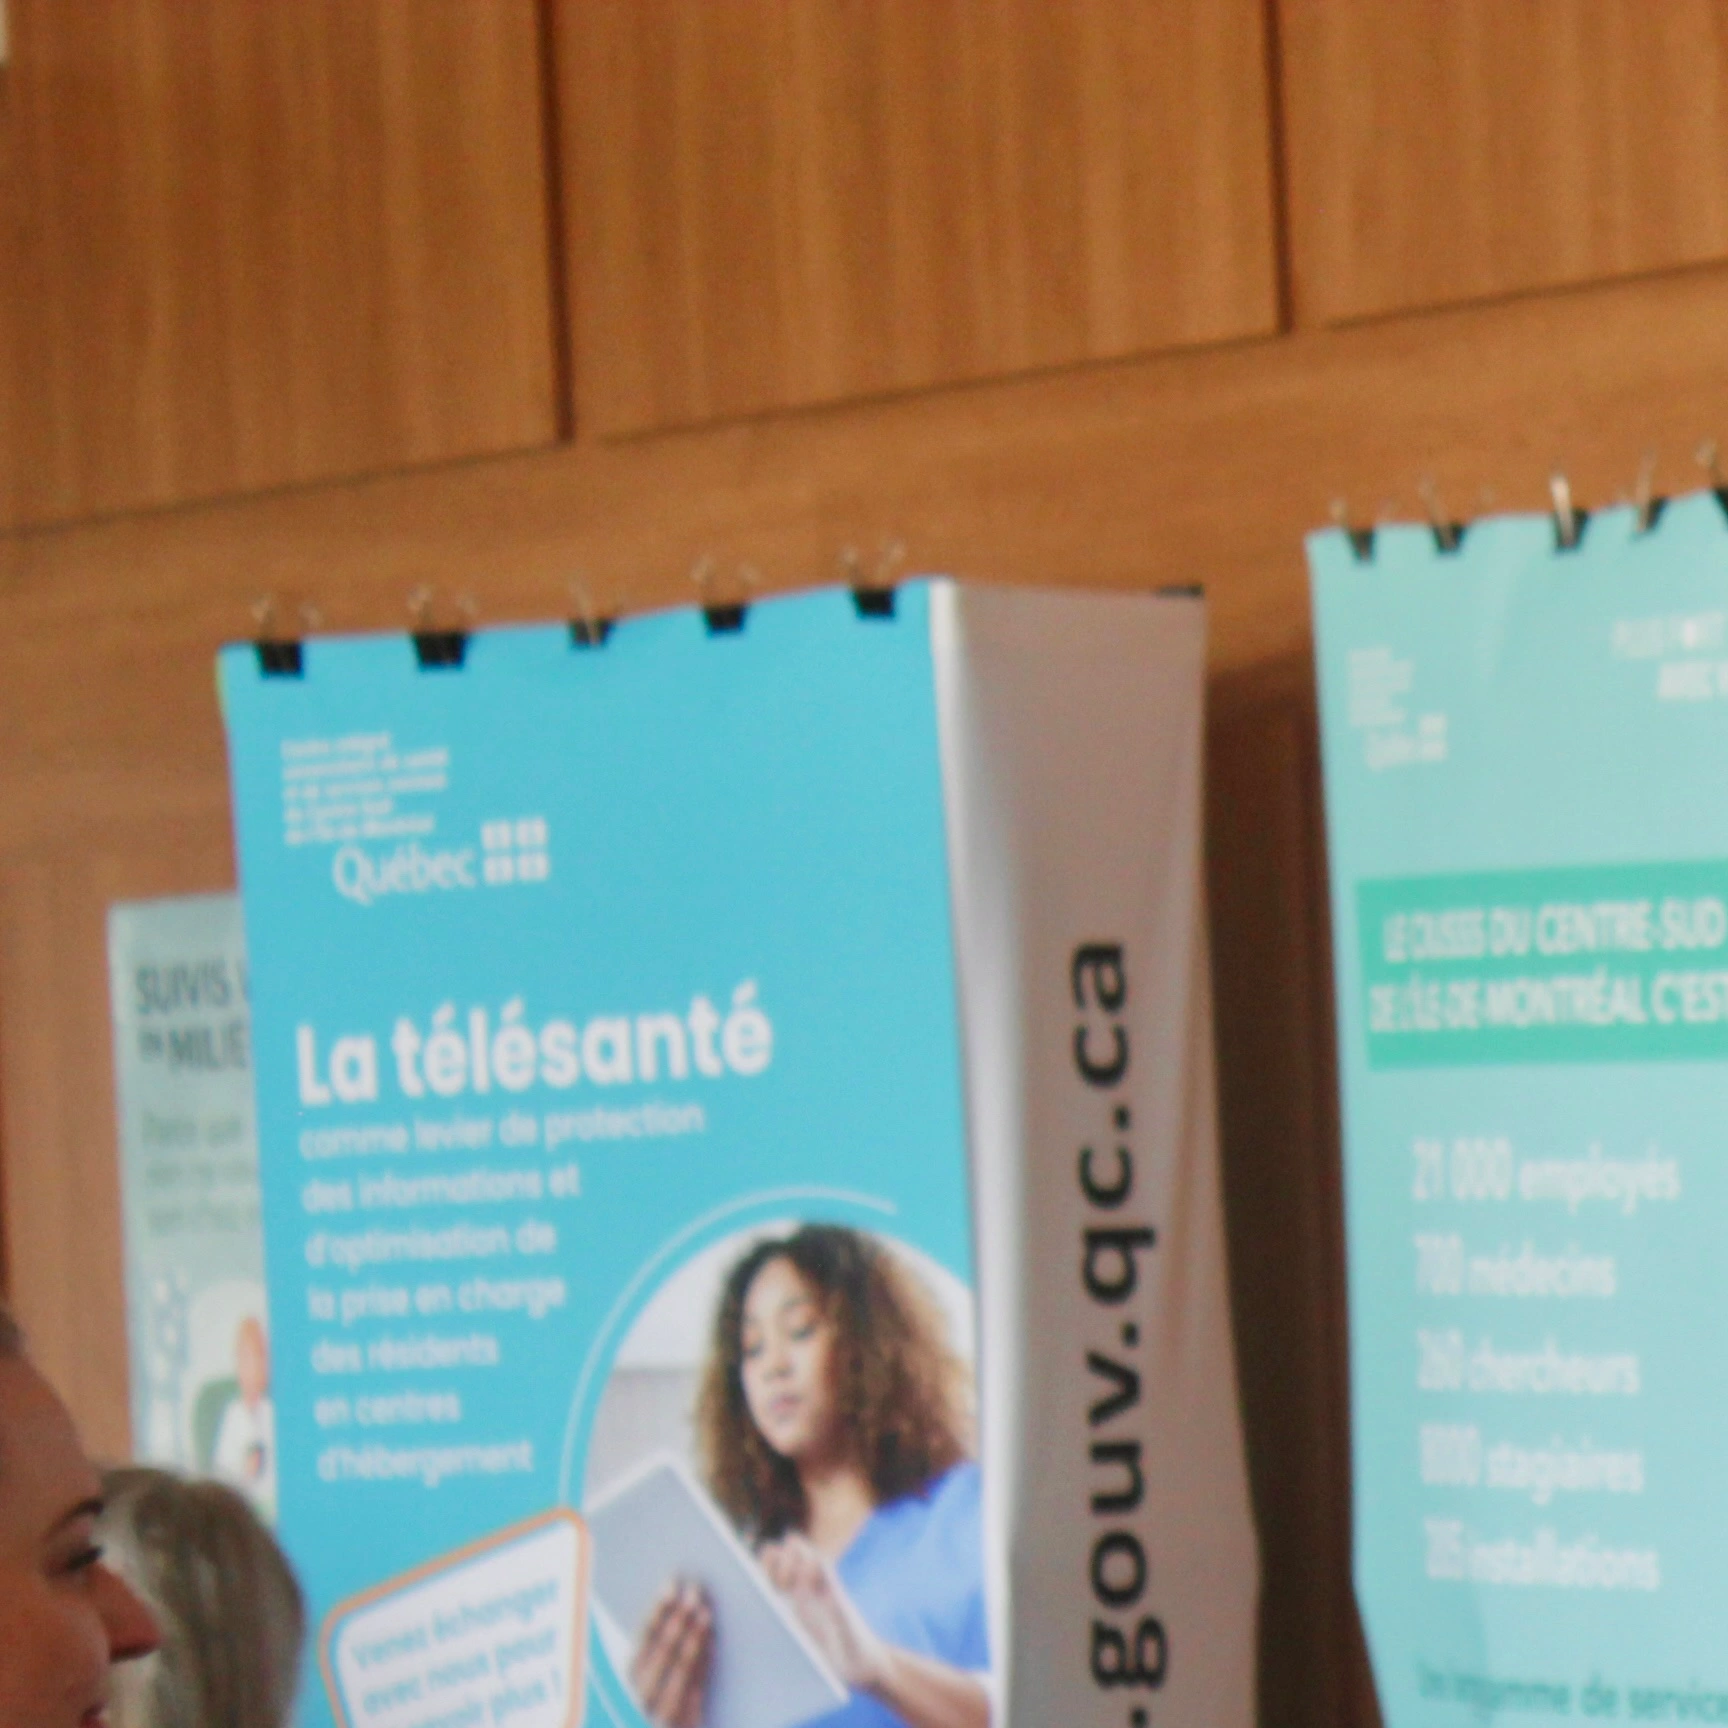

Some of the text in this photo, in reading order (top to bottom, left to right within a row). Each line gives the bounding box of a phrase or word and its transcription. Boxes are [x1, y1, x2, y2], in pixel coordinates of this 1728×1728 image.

[332, 843, 476, 905] Québec
[298, 978, 773, 1106] La télésanté
[499, 1113, 539, 1148] de
[544, 1104, 706, 1152] protection
